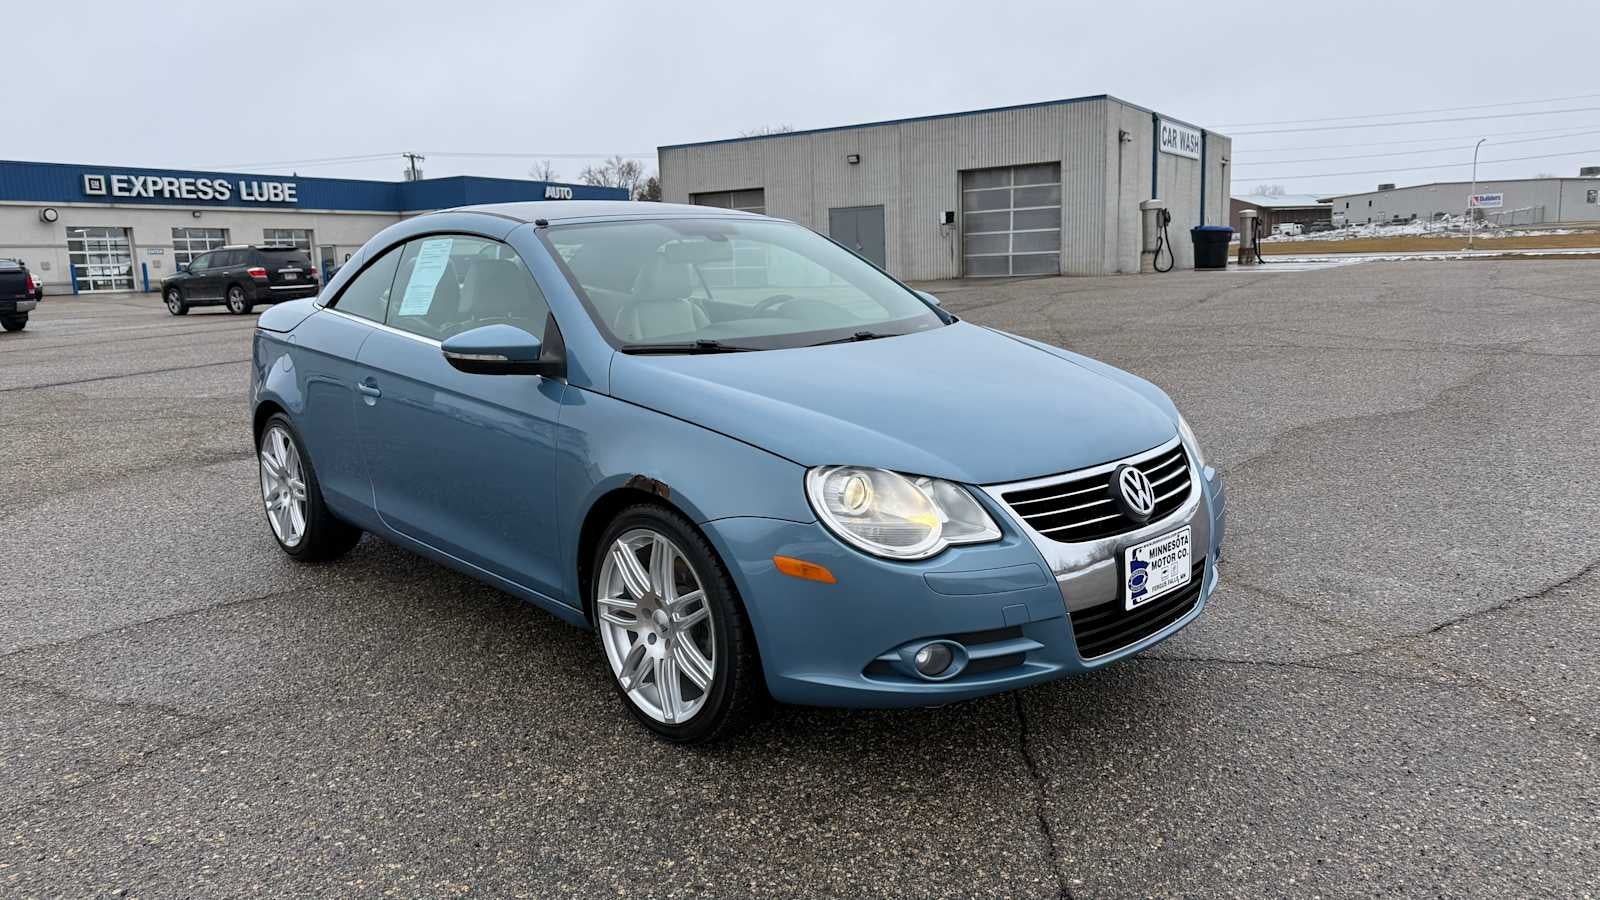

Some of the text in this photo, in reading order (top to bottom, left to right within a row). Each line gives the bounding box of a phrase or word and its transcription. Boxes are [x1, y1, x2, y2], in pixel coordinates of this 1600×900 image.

[1162, 126, 1199, 153] CAR WASH
[110, 174, 231, 200] EXPRESS
[239, 180, 298, 202] LUBE
[545, 186, 573, 199] AUTO
[1149, 535, 1189, 559] MINNESOTA
[1151, 548, 1189, 571] MOTOR CO.
